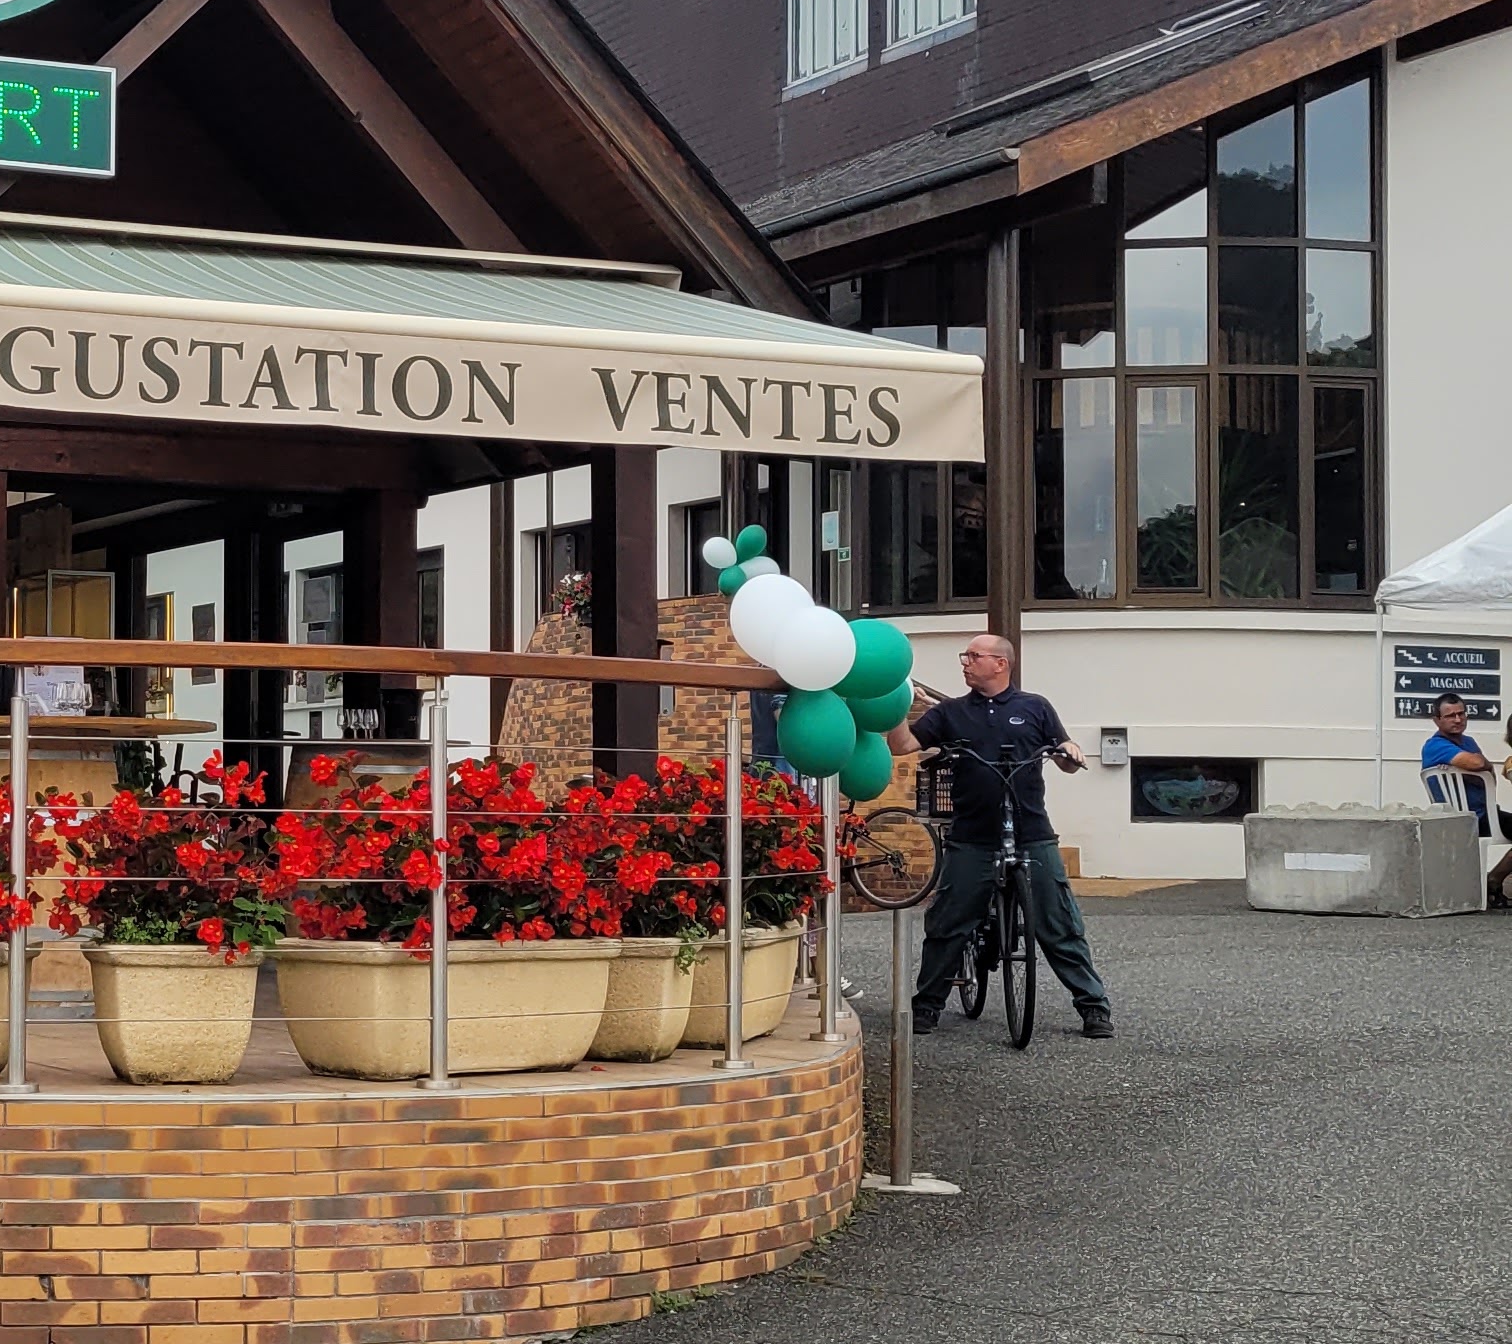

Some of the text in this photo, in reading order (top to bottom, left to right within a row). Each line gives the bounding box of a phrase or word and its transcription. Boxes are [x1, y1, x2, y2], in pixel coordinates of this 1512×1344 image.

[591, 367, 901, 448] VENTES
[1443, 652, 1486, 665] ACCUEIL
[1430, 677, 1474, 689] MAGASIN
